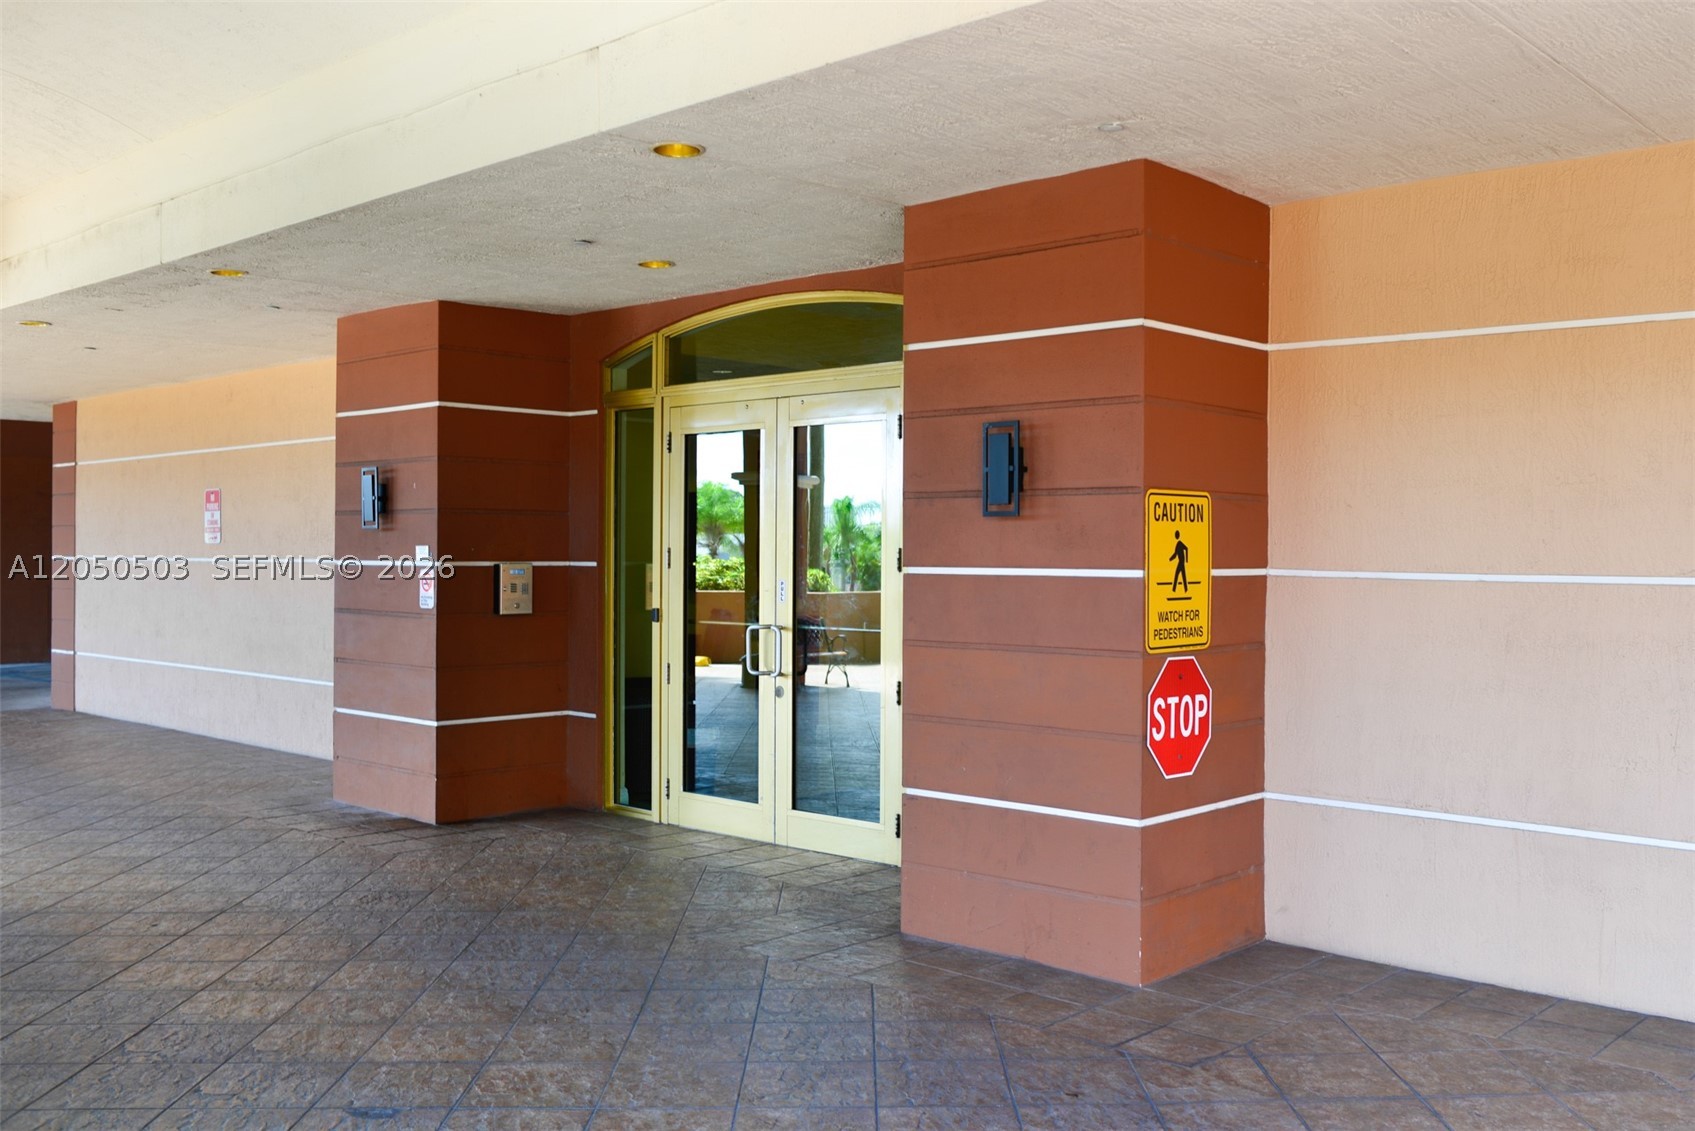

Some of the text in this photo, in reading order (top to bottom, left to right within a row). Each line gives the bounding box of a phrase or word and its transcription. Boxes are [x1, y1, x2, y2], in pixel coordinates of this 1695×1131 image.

[1153, 501, 1204, 522] CAUTION
[1157, 609, 1200, 623] WATCH FOR
[1153, 625, 1204, 641] PEDESTRIANS
[1151, 693, 1208, 742] STOP
